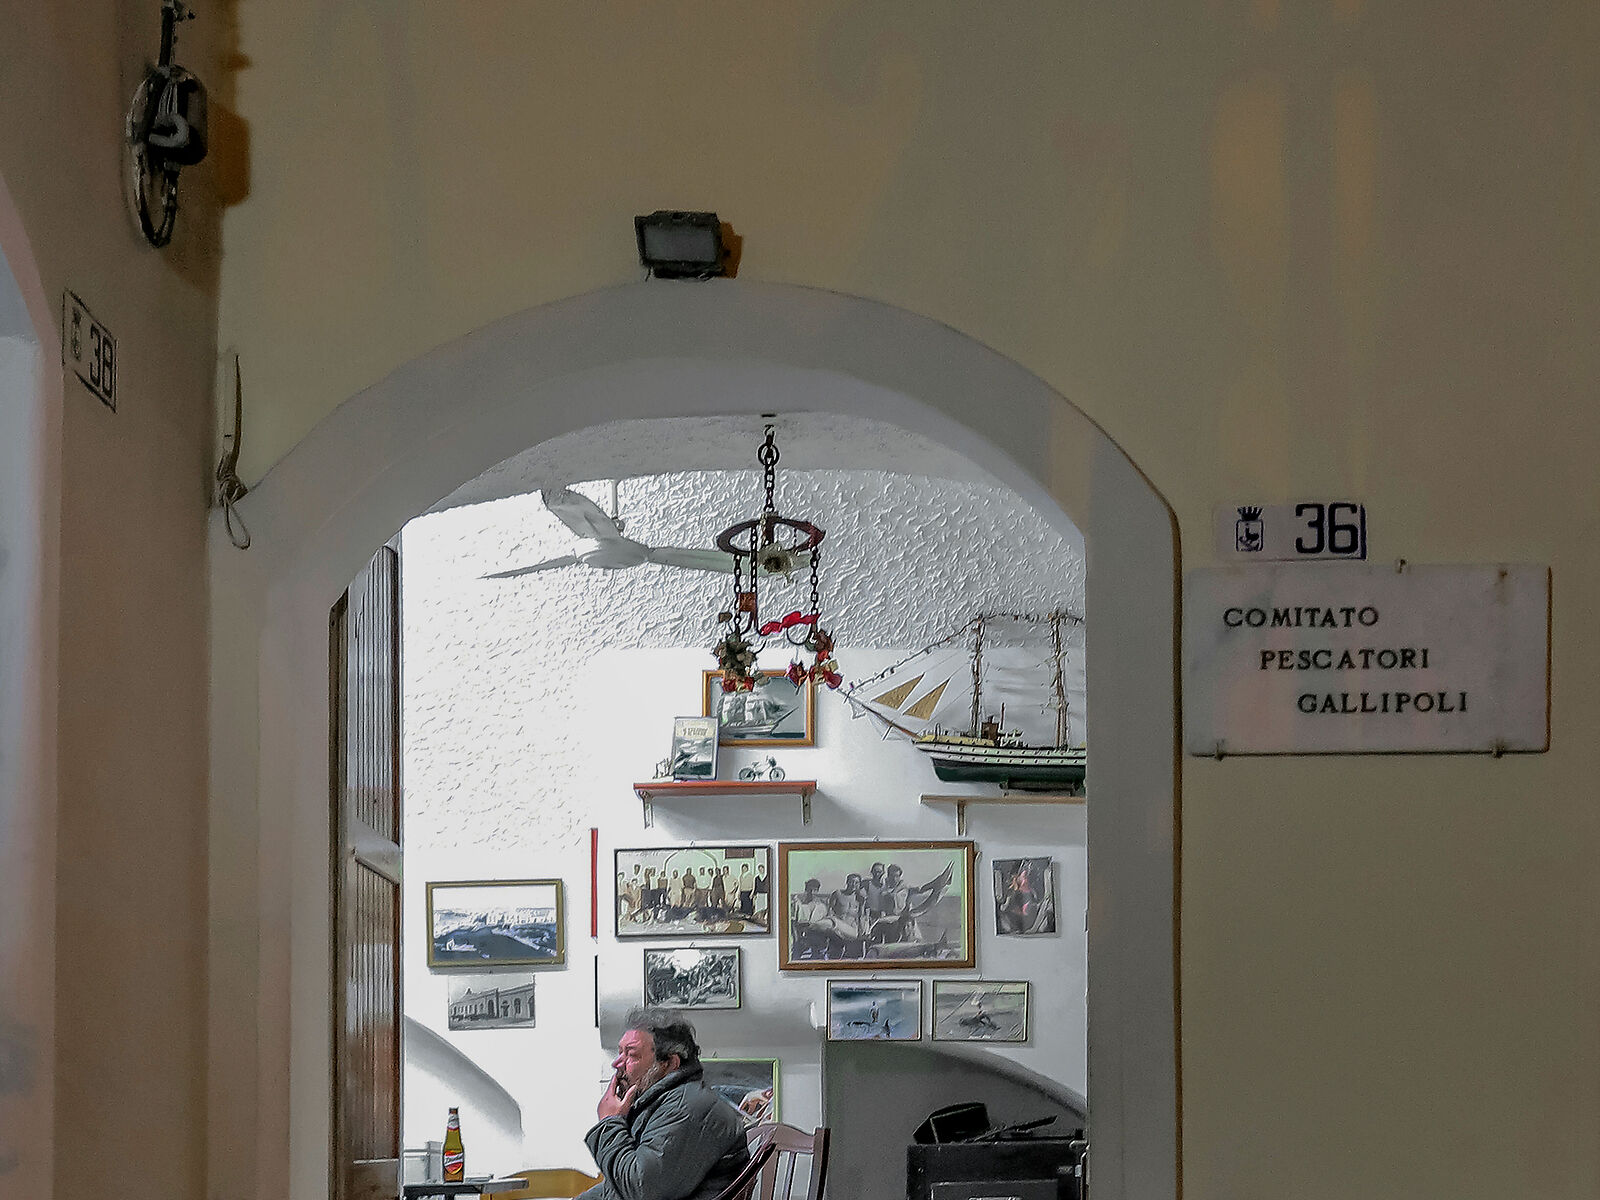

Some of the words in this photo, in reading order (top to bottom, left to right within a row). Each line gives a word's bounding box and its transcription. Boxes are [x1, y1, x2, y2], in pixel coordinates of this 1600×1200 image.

[89, 323, 113, 399] 38
[1295, 503, 1359, 554] 36
[1223, 606, 1379, 629] COMITATO
[1259, 648, 1429, 671] PESCATORI
[1297, 691, 1468, 714] GALLIPOLI
